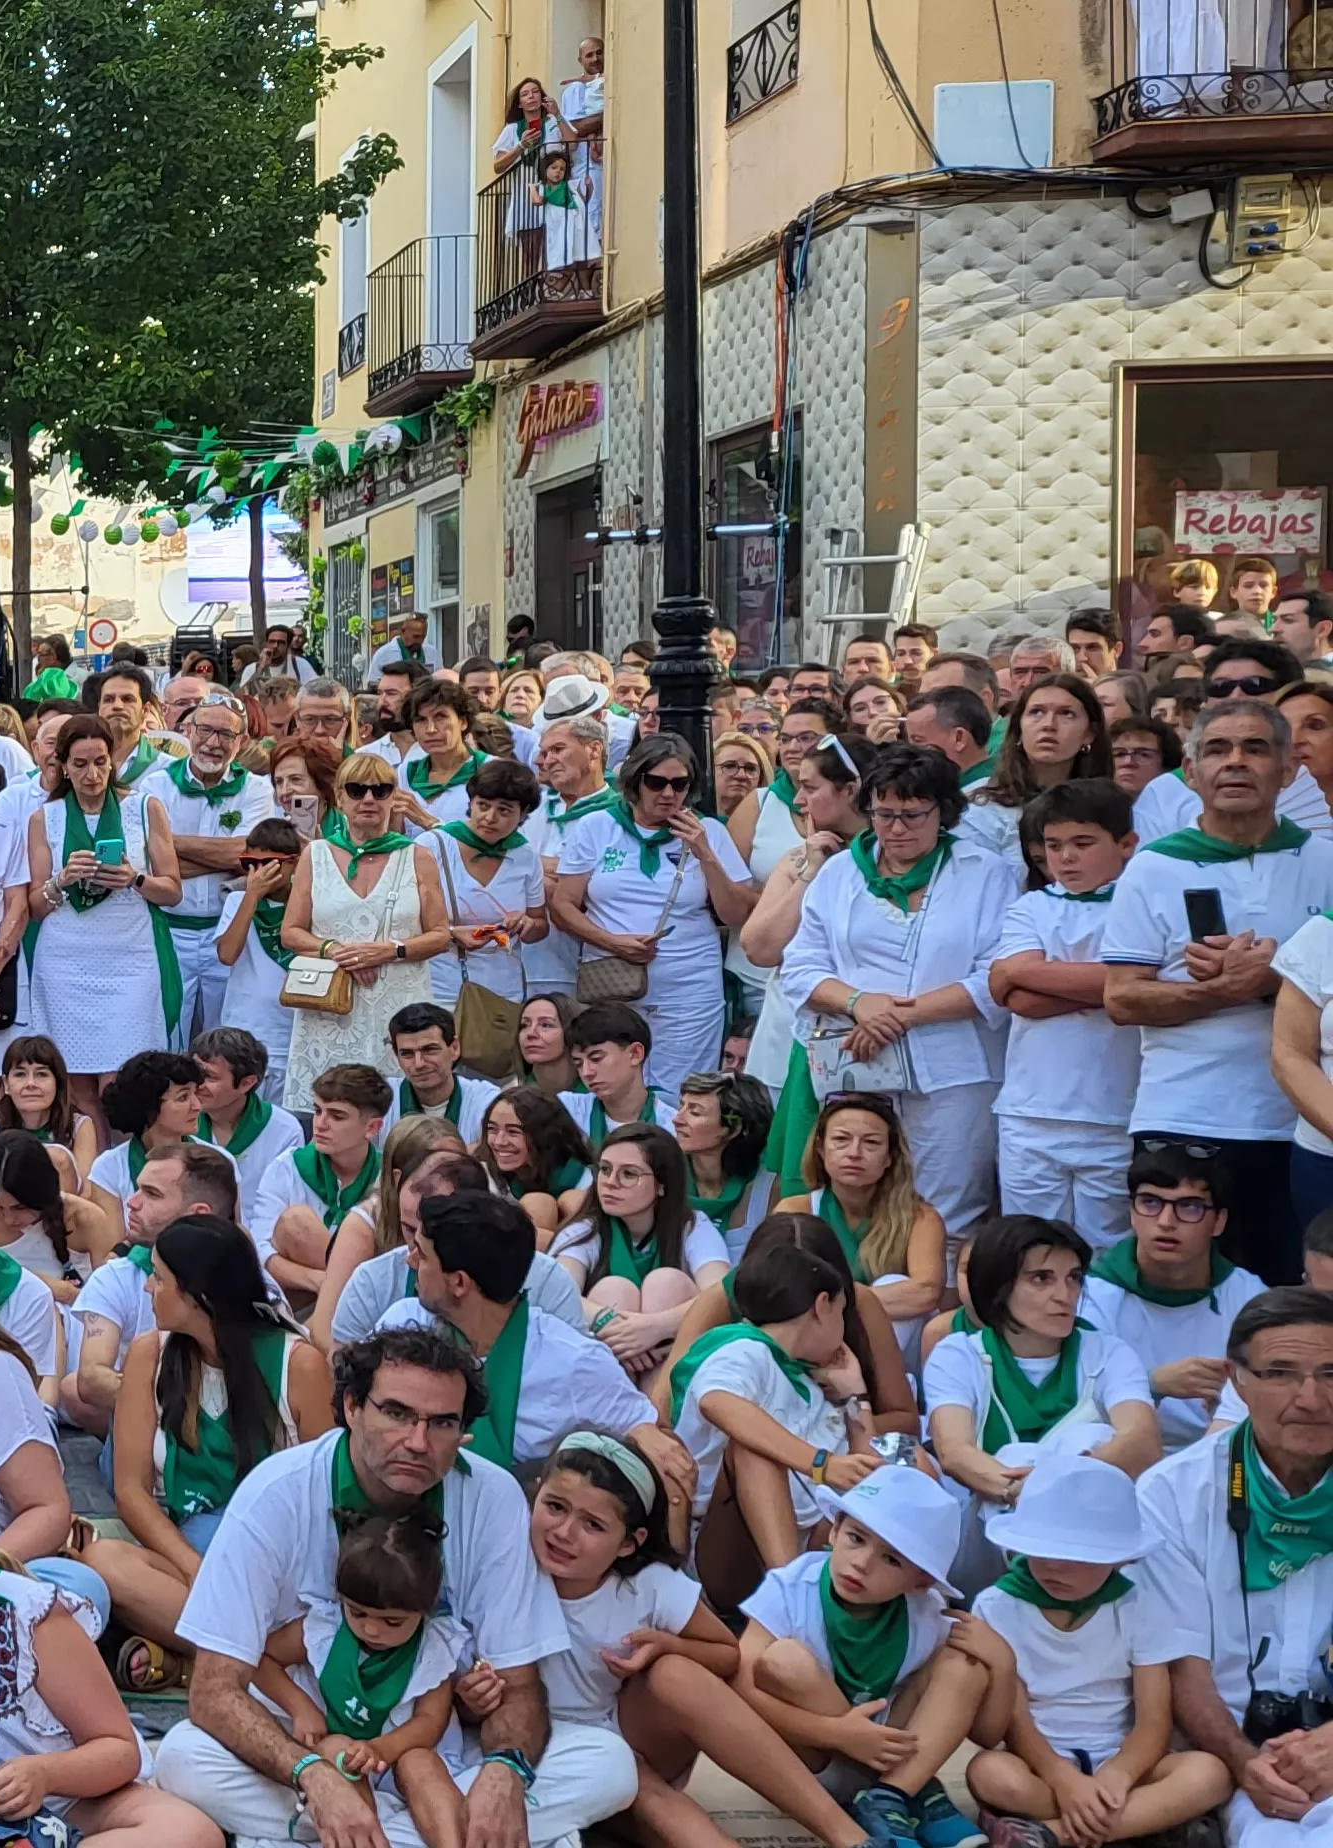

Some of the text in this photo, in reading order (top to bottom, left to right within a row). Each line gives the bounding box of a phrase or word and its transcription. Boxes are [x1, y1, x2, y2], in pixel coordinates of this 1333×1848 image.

[1182, 503, 1317, 544] Rebajas
[746, 546, 776, 575] Rebaj
[1232, 1462, 1243, 1499] Nikon
